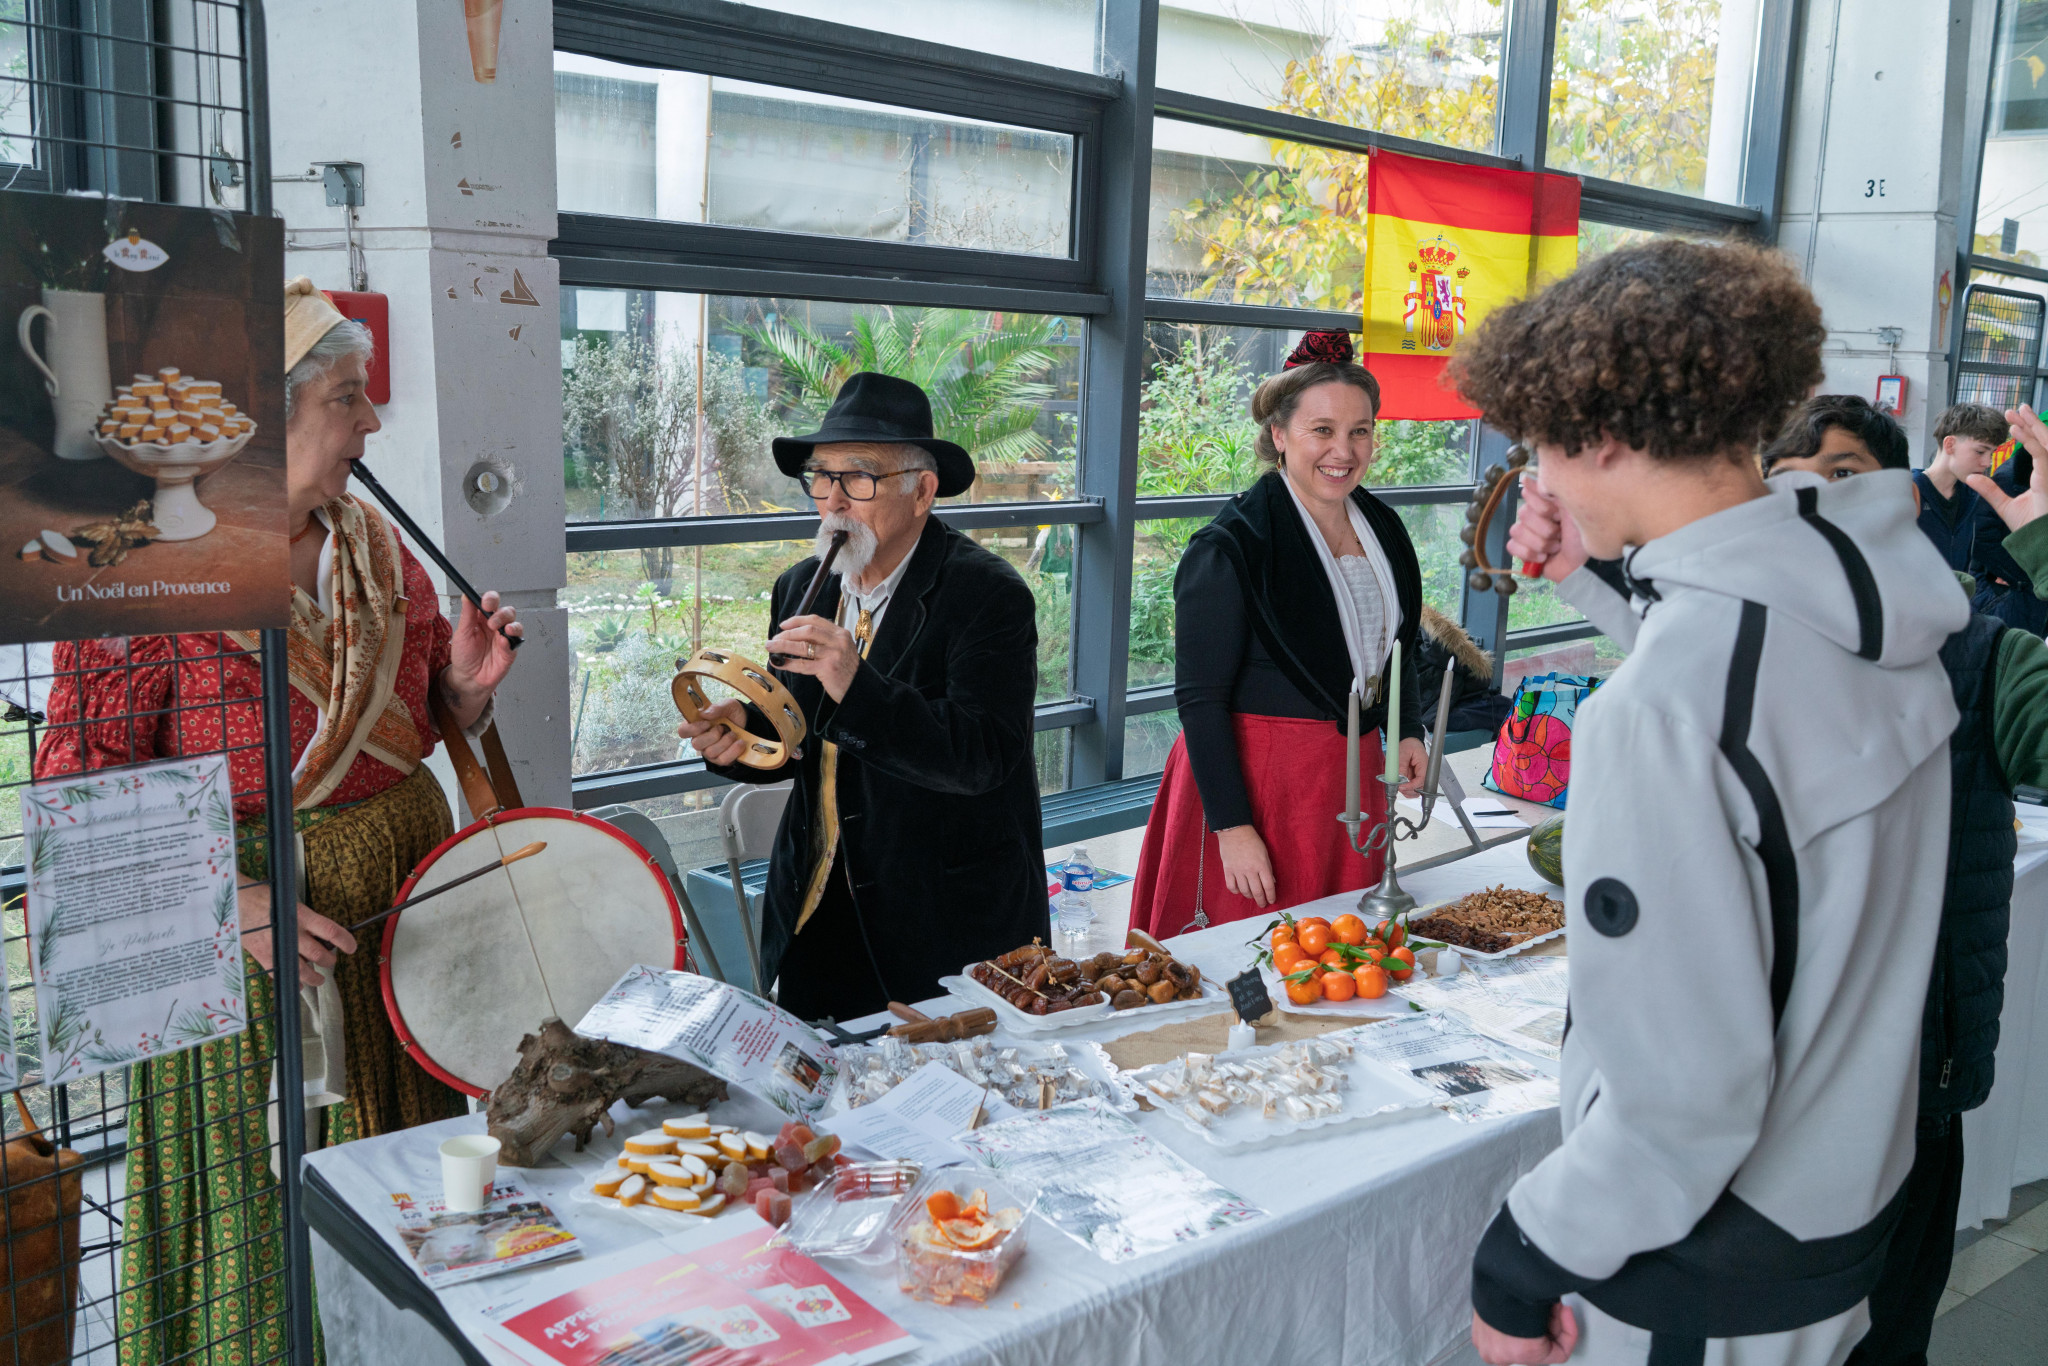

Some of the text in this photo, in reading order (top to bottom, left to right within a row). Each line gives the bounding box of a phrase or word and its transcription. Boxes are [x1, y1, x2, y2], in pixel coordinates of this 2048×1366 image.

[56, 579, 231, 602] Un Noël en Provence
[561, 1328, 591, 1349] LE
